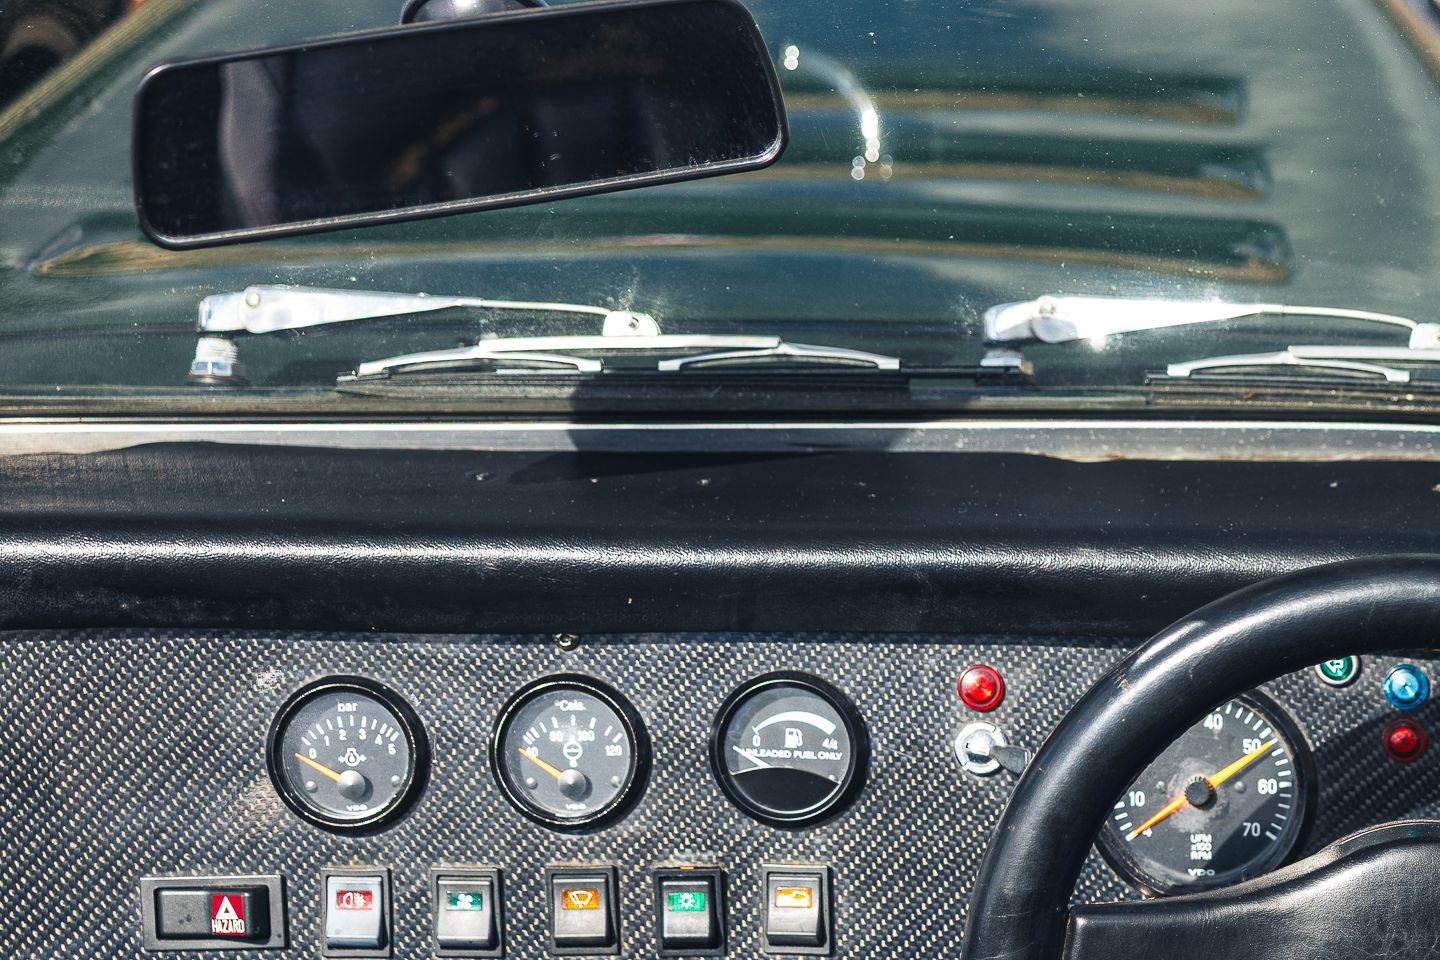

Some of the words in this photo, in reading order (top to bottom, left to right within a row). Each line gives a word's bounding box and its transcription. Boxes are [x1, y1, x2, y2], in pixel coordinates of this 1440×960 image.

[338, 702, 358, 712] bar
[1203, 714, 1223, 730] 40
[339, 729, 348, 741] 2
[358, 728, 367, 740] 3
[374, 734, 383, 746] 4
[576, 730, 595, 742] 100
[324, 735, 331, 747] 1
[752, 734, 761, 747] 0
[604, 745, 623, 757] 120
[1242, 739, 1261, 755] 50
[309, 748, 317, 759] 0
[793, 751, 818, 760] FUEL
[817, 752, 843, 760] ONLY
[1257, 779, 1278, 795] 60
[1128, 790, 1146, 807] 10
[1242, 822, 1261, 837] 70
[1190, 833, 1212, 843] UPM
[1190, 850, 1213, 861] RPM
[1187, 868, 1216, 877] VDO
[211, 918, 245, 934] HAZARD
